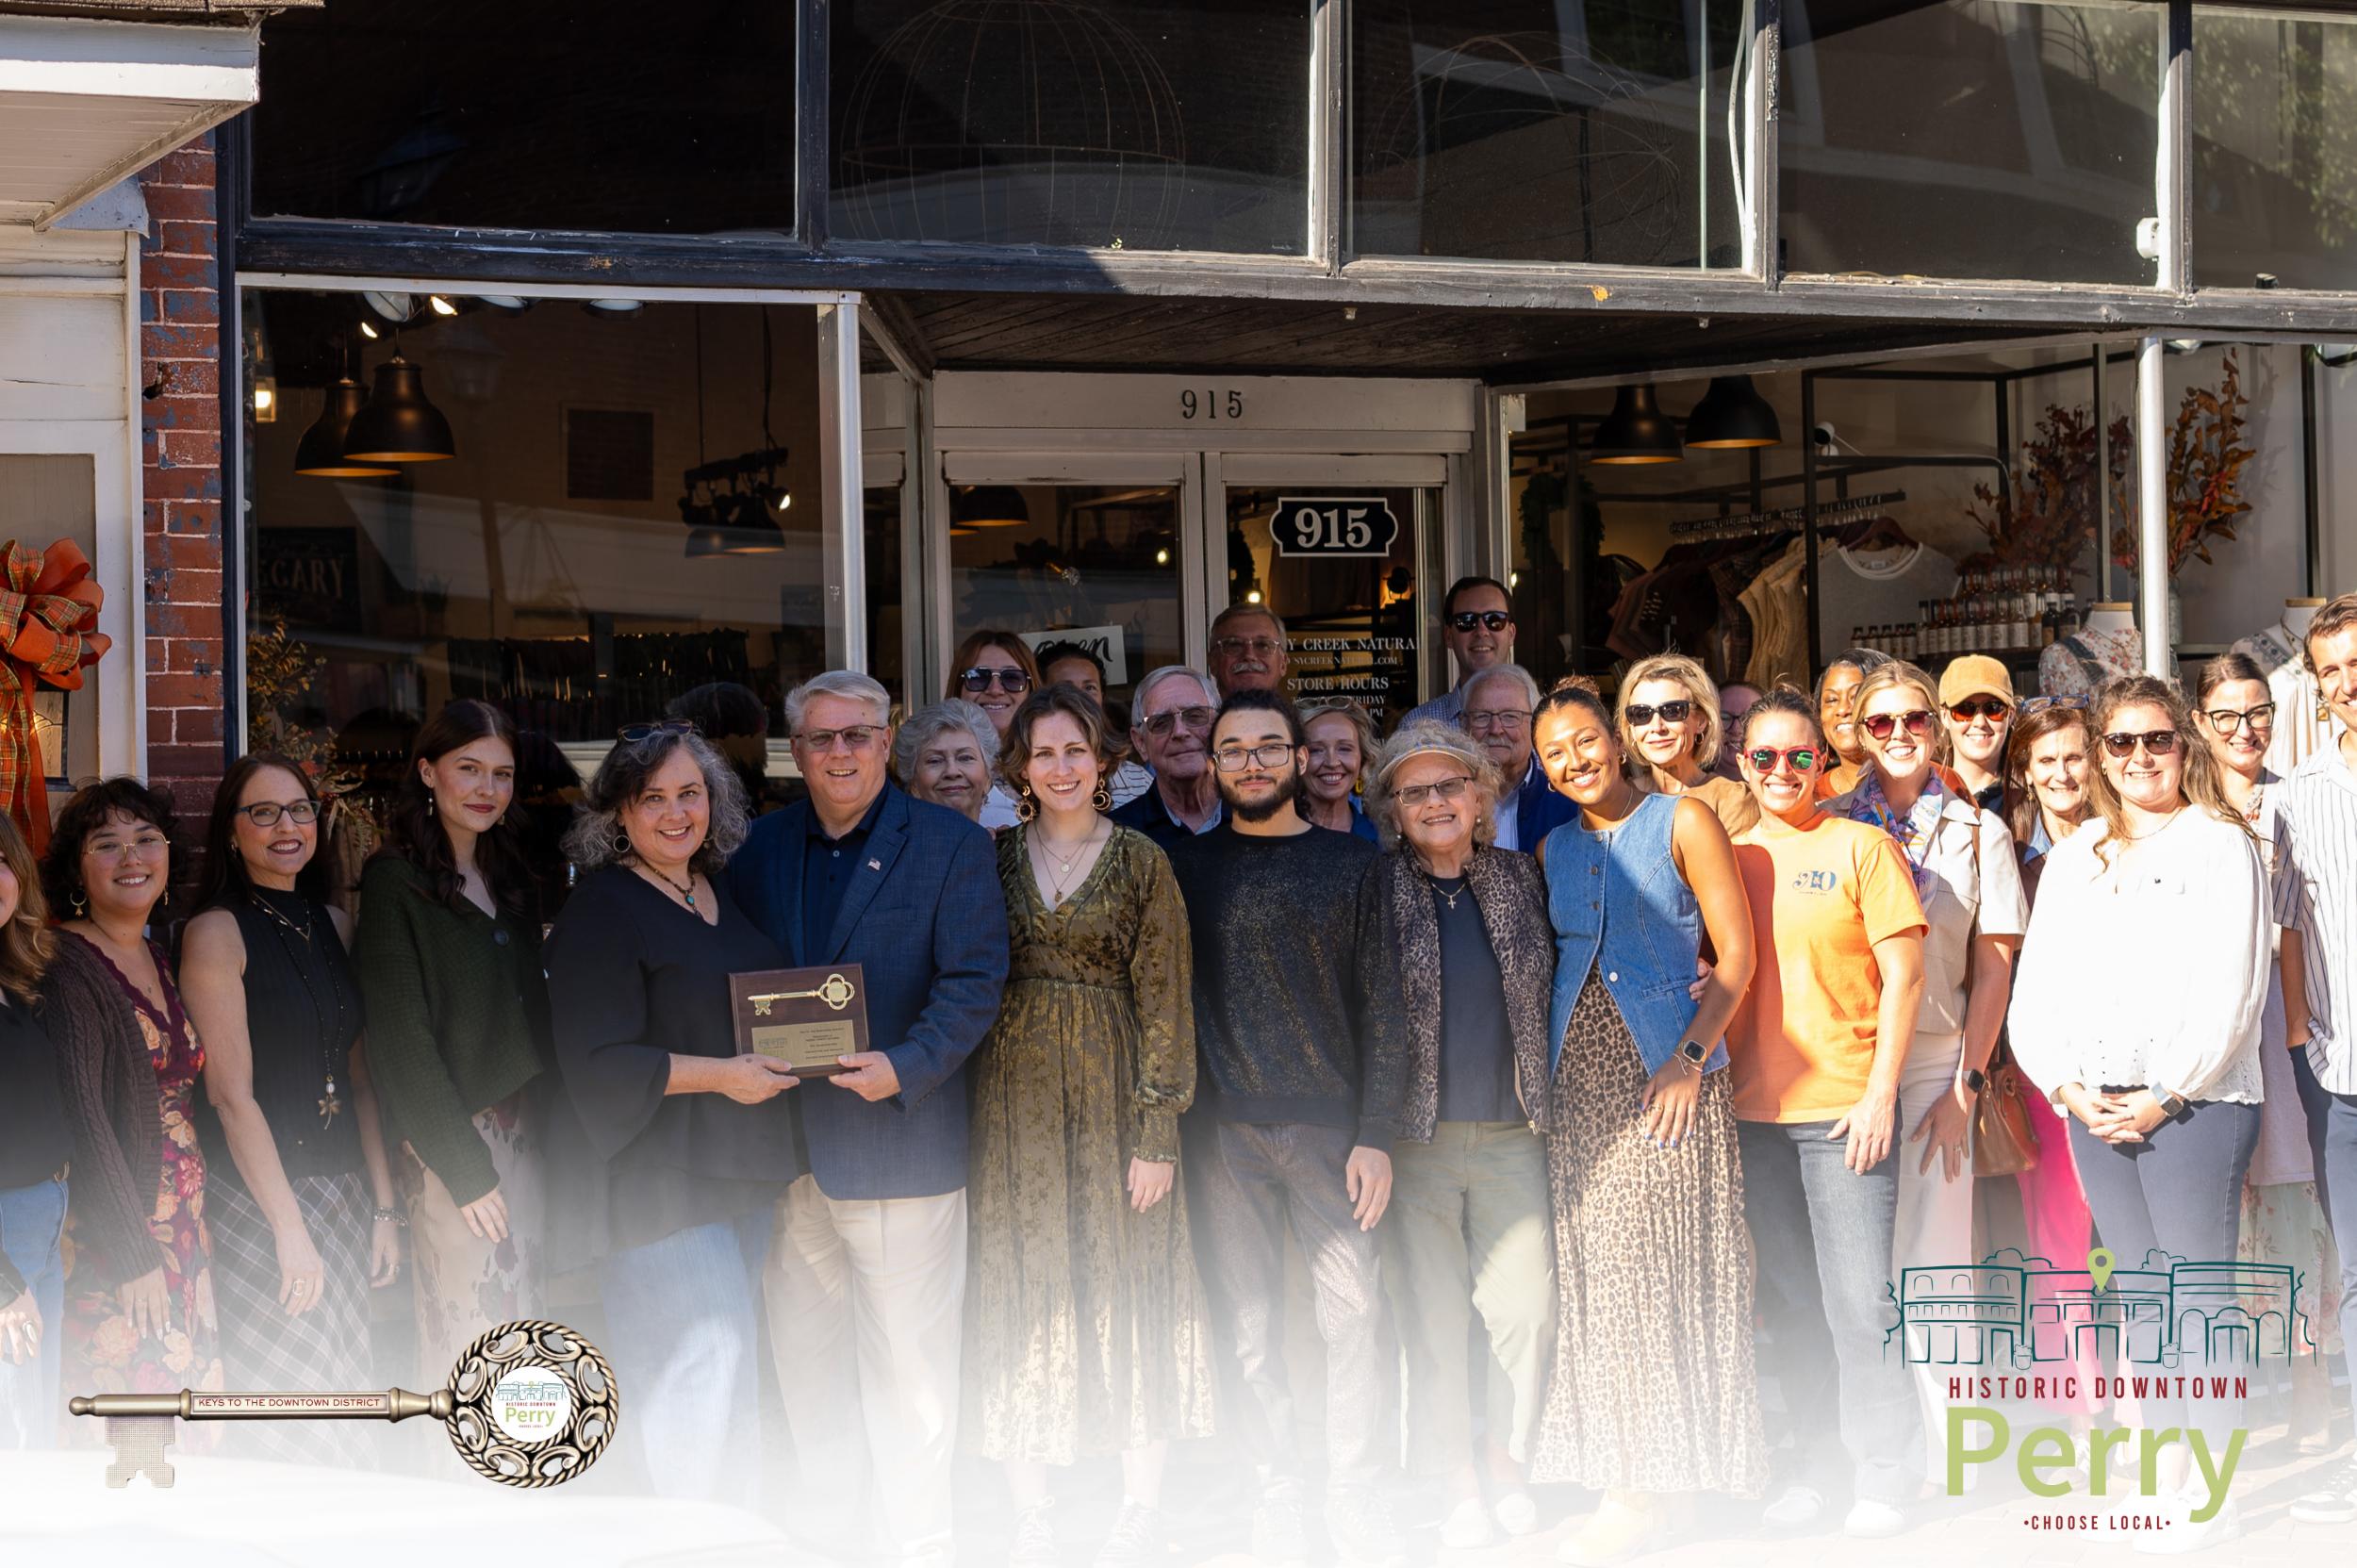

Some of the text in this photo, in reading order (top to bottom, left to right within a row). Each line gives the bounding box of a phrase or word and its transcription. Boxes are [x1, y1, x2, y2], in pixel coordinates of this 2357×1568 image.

[1181, 389, 1244, 420] 915
[1294, 508, 1372, 549] 915
[1303, 637, 1350, 651] CREEK
[1287, 676, 1389, 691] STORE HOURS
